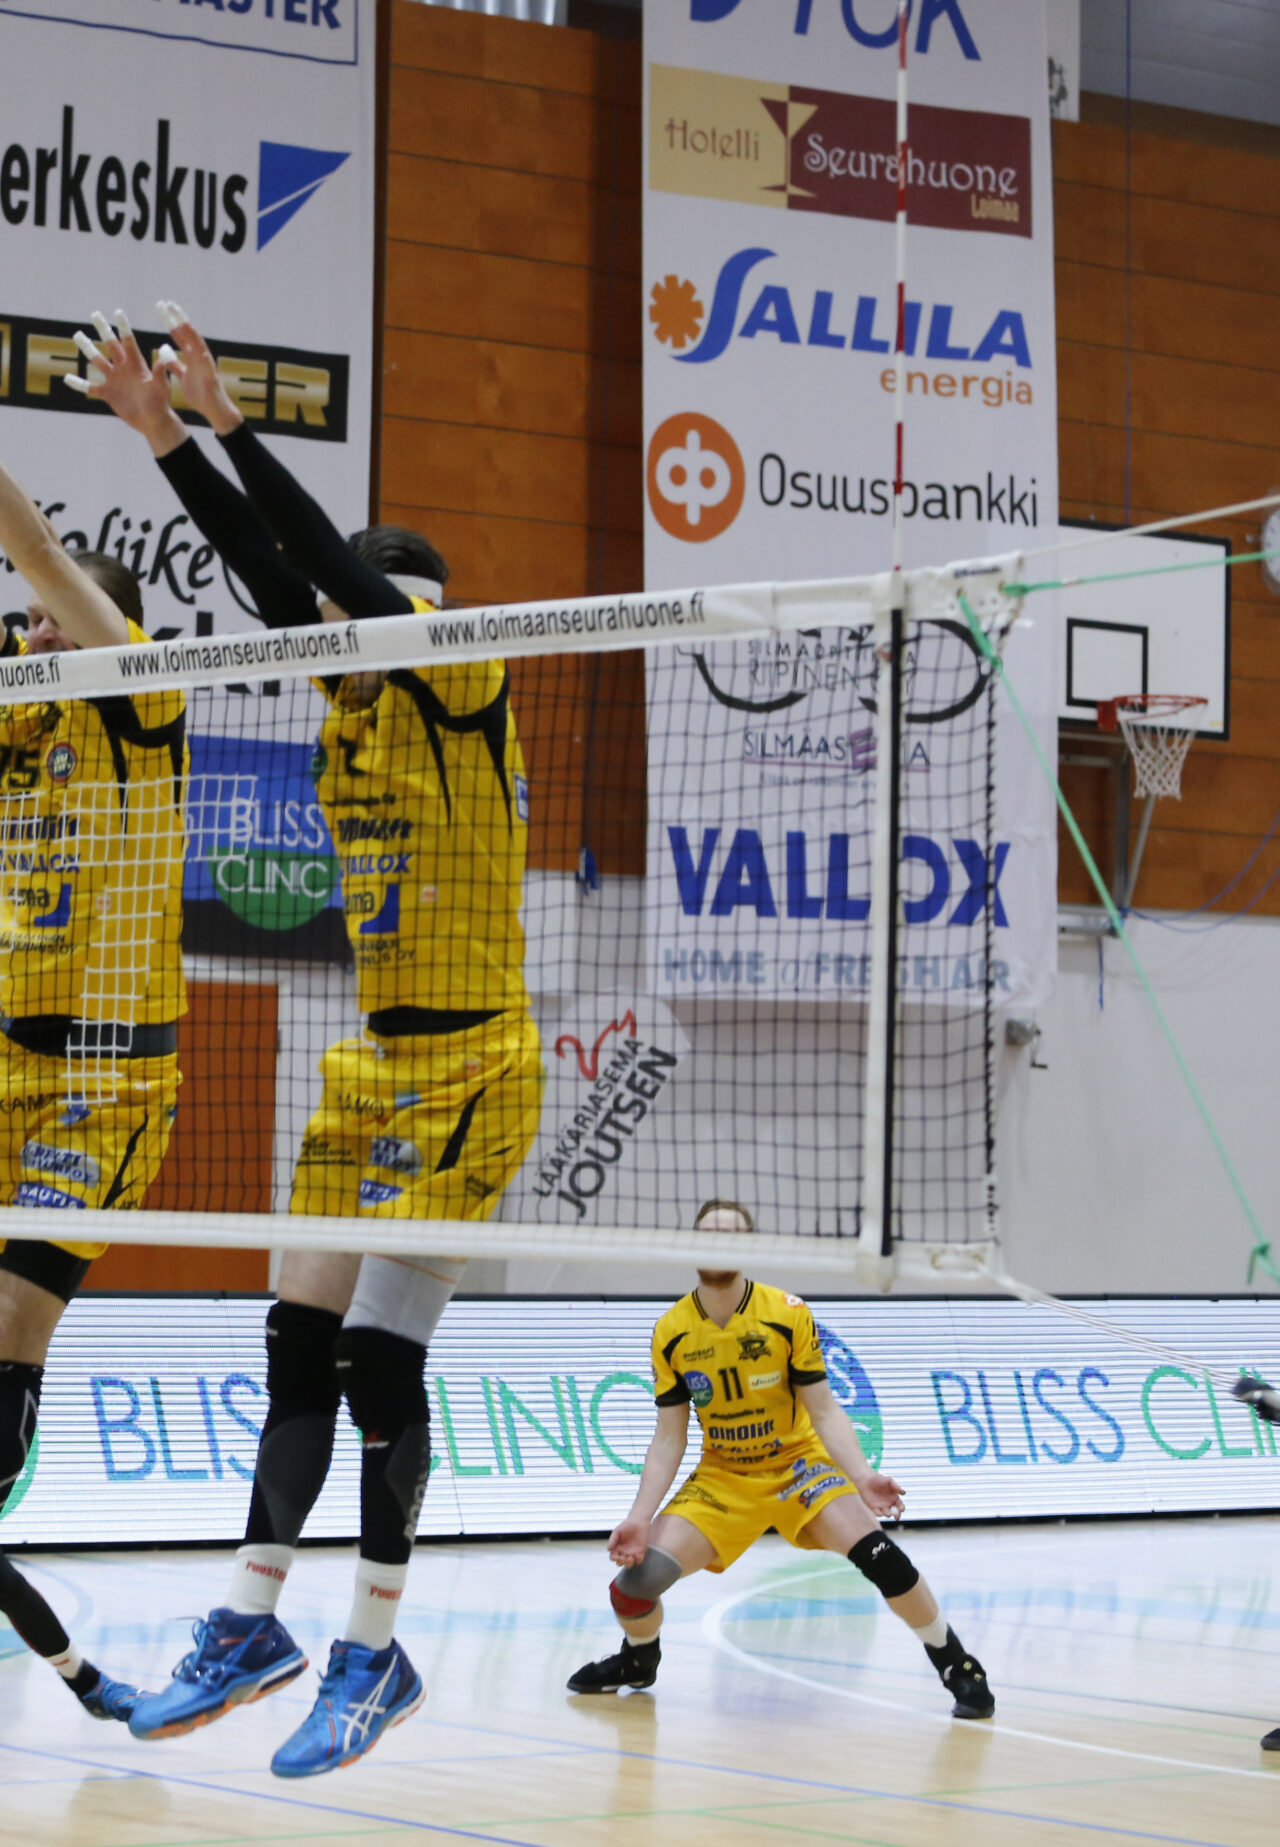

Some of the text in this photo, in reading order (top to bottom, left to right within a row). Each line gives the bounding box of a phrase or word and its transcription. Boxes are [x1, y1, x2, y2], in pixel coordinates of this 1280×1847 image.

[665, 116, 761, 163] Hotelli
[804, 133, 1020, 199] Seurahuone
[670, 247, 1033, 368] SALLILA
[880, 369, 1034, 407] energia
[760, 453, 1039, 528] Osuuspankki
[427, 591, 706, 648] www.loimaanseurahuone.fi
[118, 624, 360, 679] www.loimaanseurahuone.fi
[231, 797, 325, 850] BLISS
[217, 857, 328, 899] CLINIC
[667, 826, 1011, 928] VALLOX
[664, 948, 767, 986] HOME
[557, 1046, 678, 1219] JOUTSEN
[718, 1366, 744, 1402] 11
[930, 1367, 1125, 1464] BLISS
